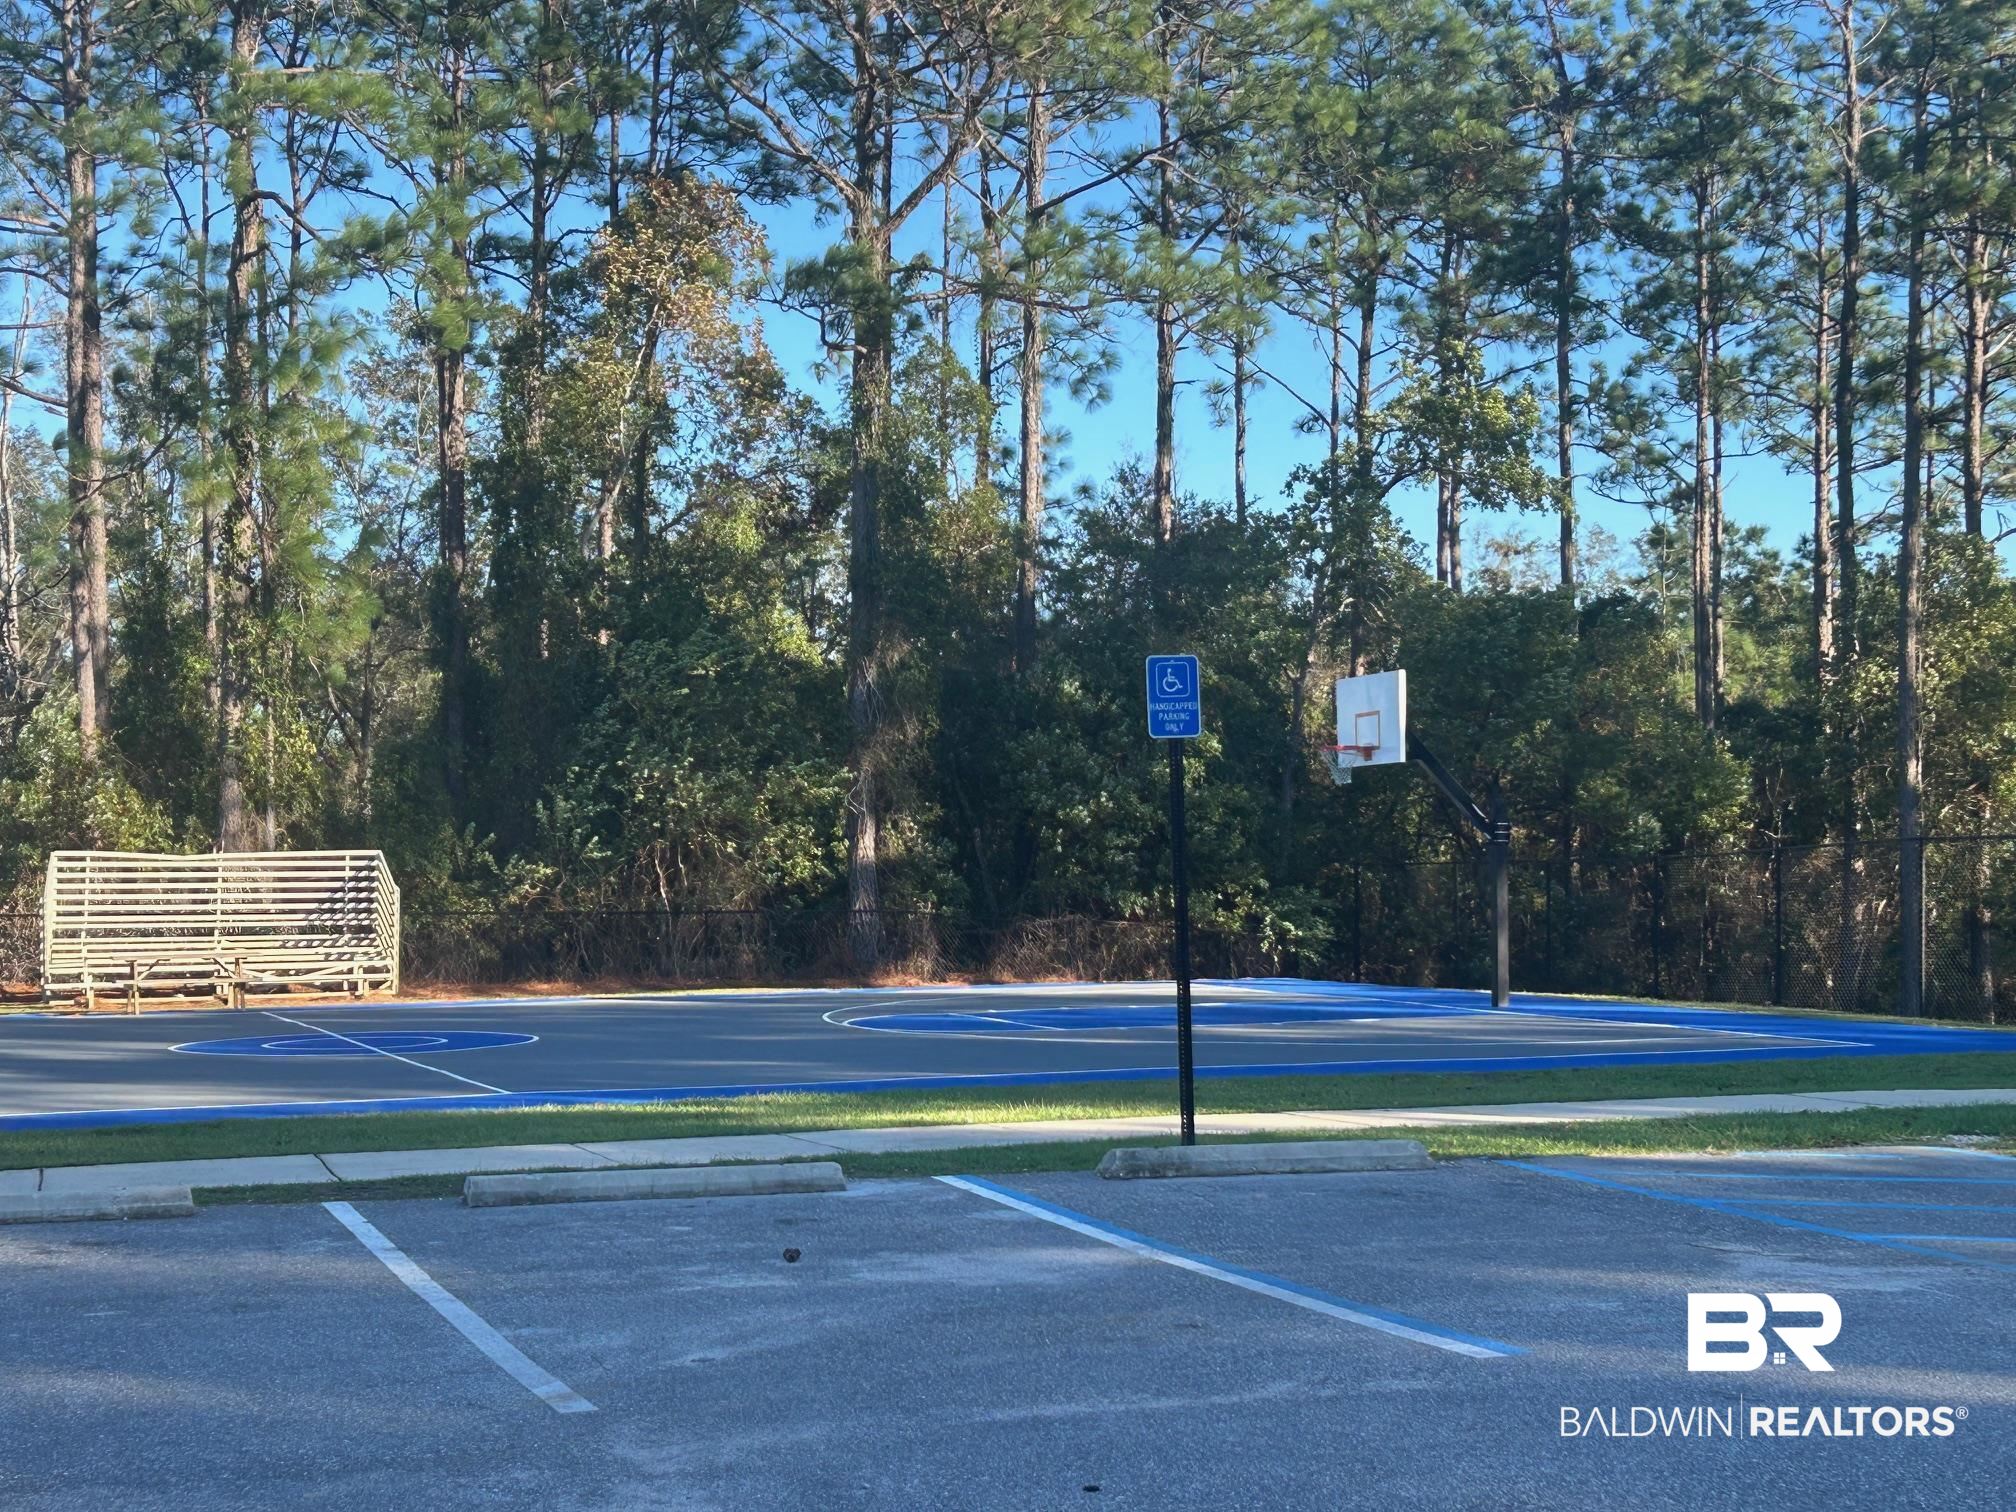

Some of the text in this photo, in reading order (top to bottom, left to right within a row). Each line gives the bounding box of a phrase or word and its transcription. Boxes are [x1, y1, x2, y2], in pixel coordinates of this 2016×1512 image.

[1150, 701, 1197, 711] HANDICAPPED
[1158, 712, 1190, 721] PARKING
[1164, 722, 1184, 732] ONLY
